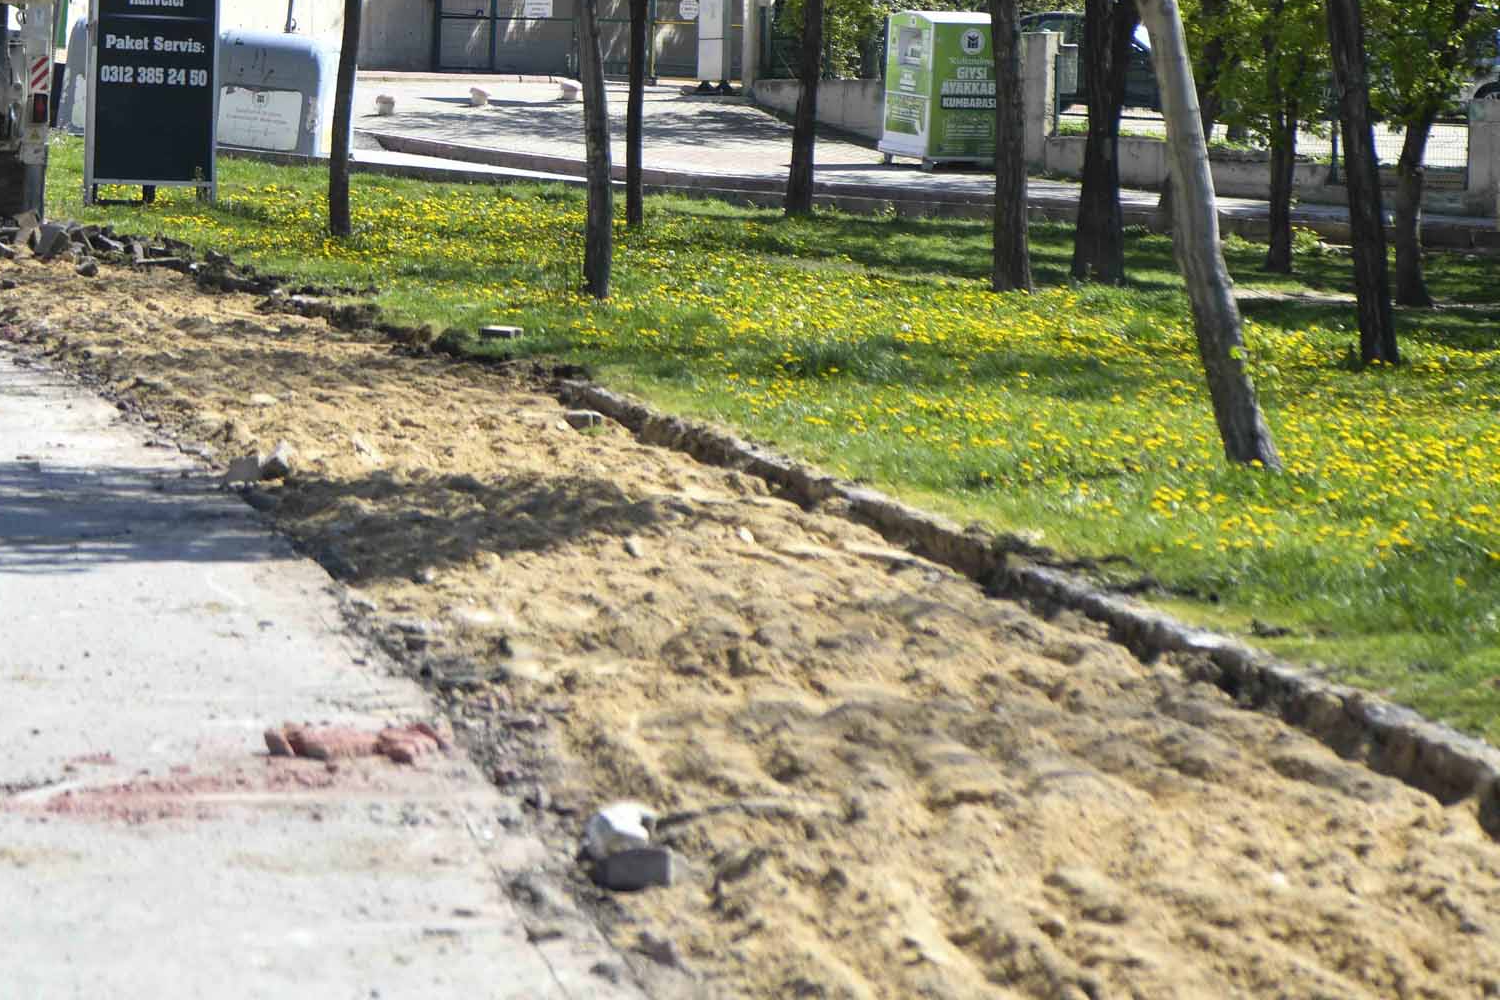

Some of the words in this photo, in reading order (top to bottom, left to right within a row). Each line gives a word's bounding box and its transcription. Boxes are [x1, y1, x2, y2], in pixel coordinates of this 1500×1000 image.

[105, 34, 150, 51] Paket
[100, 65, 134, 83] 0312
[137, 66, 164, 84] 385
[167, 68, 187, 85] 24
[189, 69, 208, 86] 50
[941, 81, 996, 96] AYAKKAB
